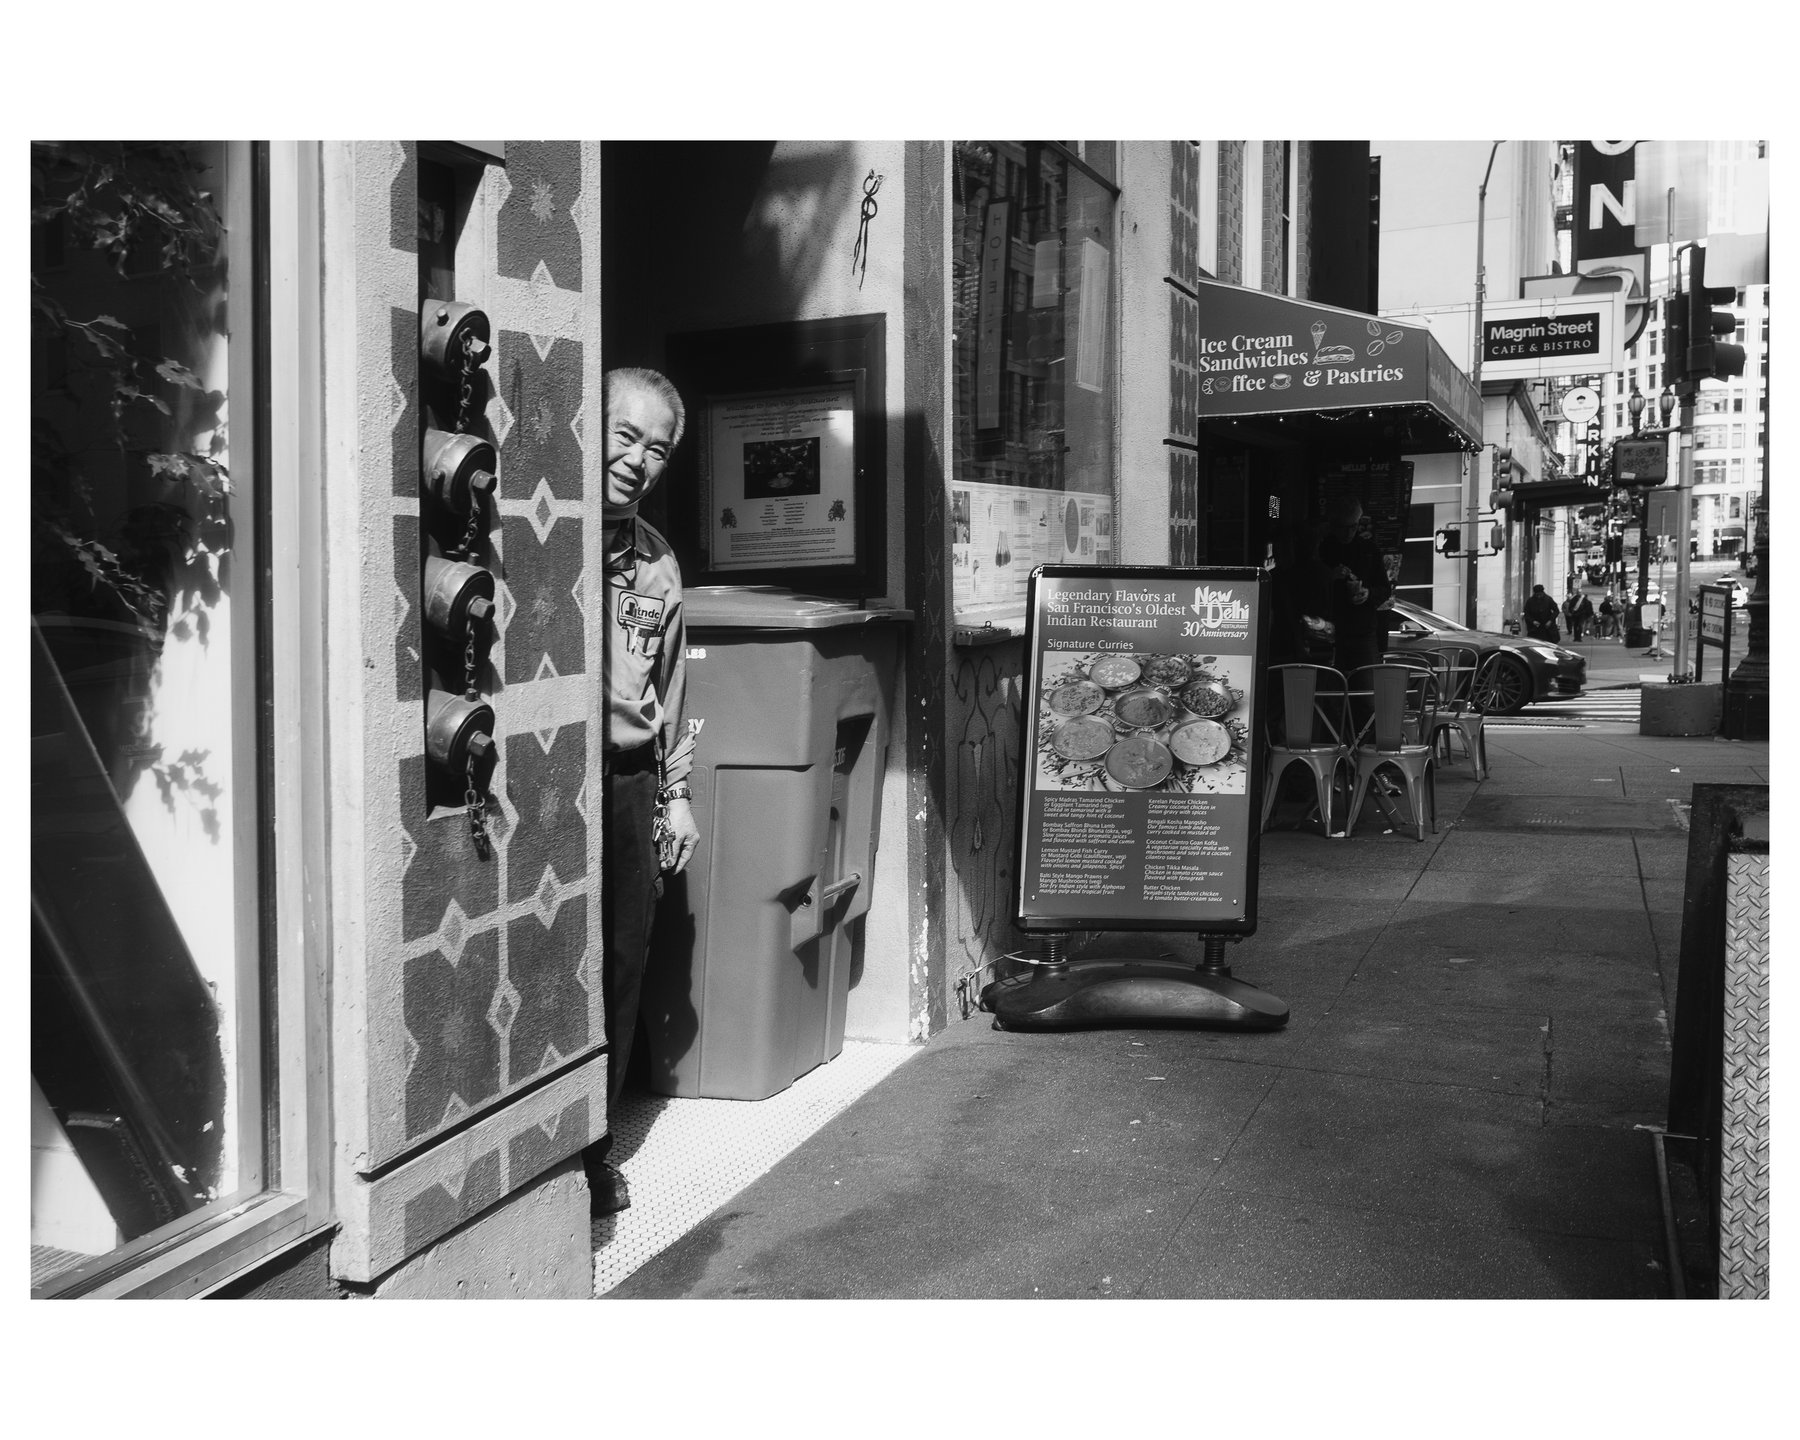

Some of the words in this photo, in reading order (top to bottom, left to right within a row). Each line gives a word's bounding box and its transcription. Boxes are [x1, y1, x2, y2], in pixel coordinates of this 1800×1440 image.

[1491, 324, 1545, 342] Magnin
[1548, 320, 1593, 336] Street
[1200, 338, 1227, 354] Ice
[1231, 334, 1293, 350] Cream
[1492, 344, 1525, 355] CAFE
[1529, 343, 1538, 352] &
[1543, 339, 1592, 351] BISTRO
[1199, 350, 1309, 373] Sandwiches
[1303, 370, 1322, 387] &
[1326, 364, 1404, 386] Pastries
[1047, 589, 1112, 603] Legendary
[1115, 590, 1160, 603] Flavors
[1164, 592, 1176, 603] at
[1192, 585, 1233, 609] New
[638, 607, 660, 619] tndc
[1047, 602, 1070, 613] San
[1074, 603, 1142, 615] Francisco's
[1145, 604, 1186, 616] Oldest
[1201, 600, 1250, 628] Delhi
[1047, 615, 1087, 627] Indian
[1090, 616, 1158, 629] Restaurant
[1199, 628, 1248, 639] Anniversary
[1047, 638, 1095, 650] Signature
[1098, 640, 1134, 650] Curries
